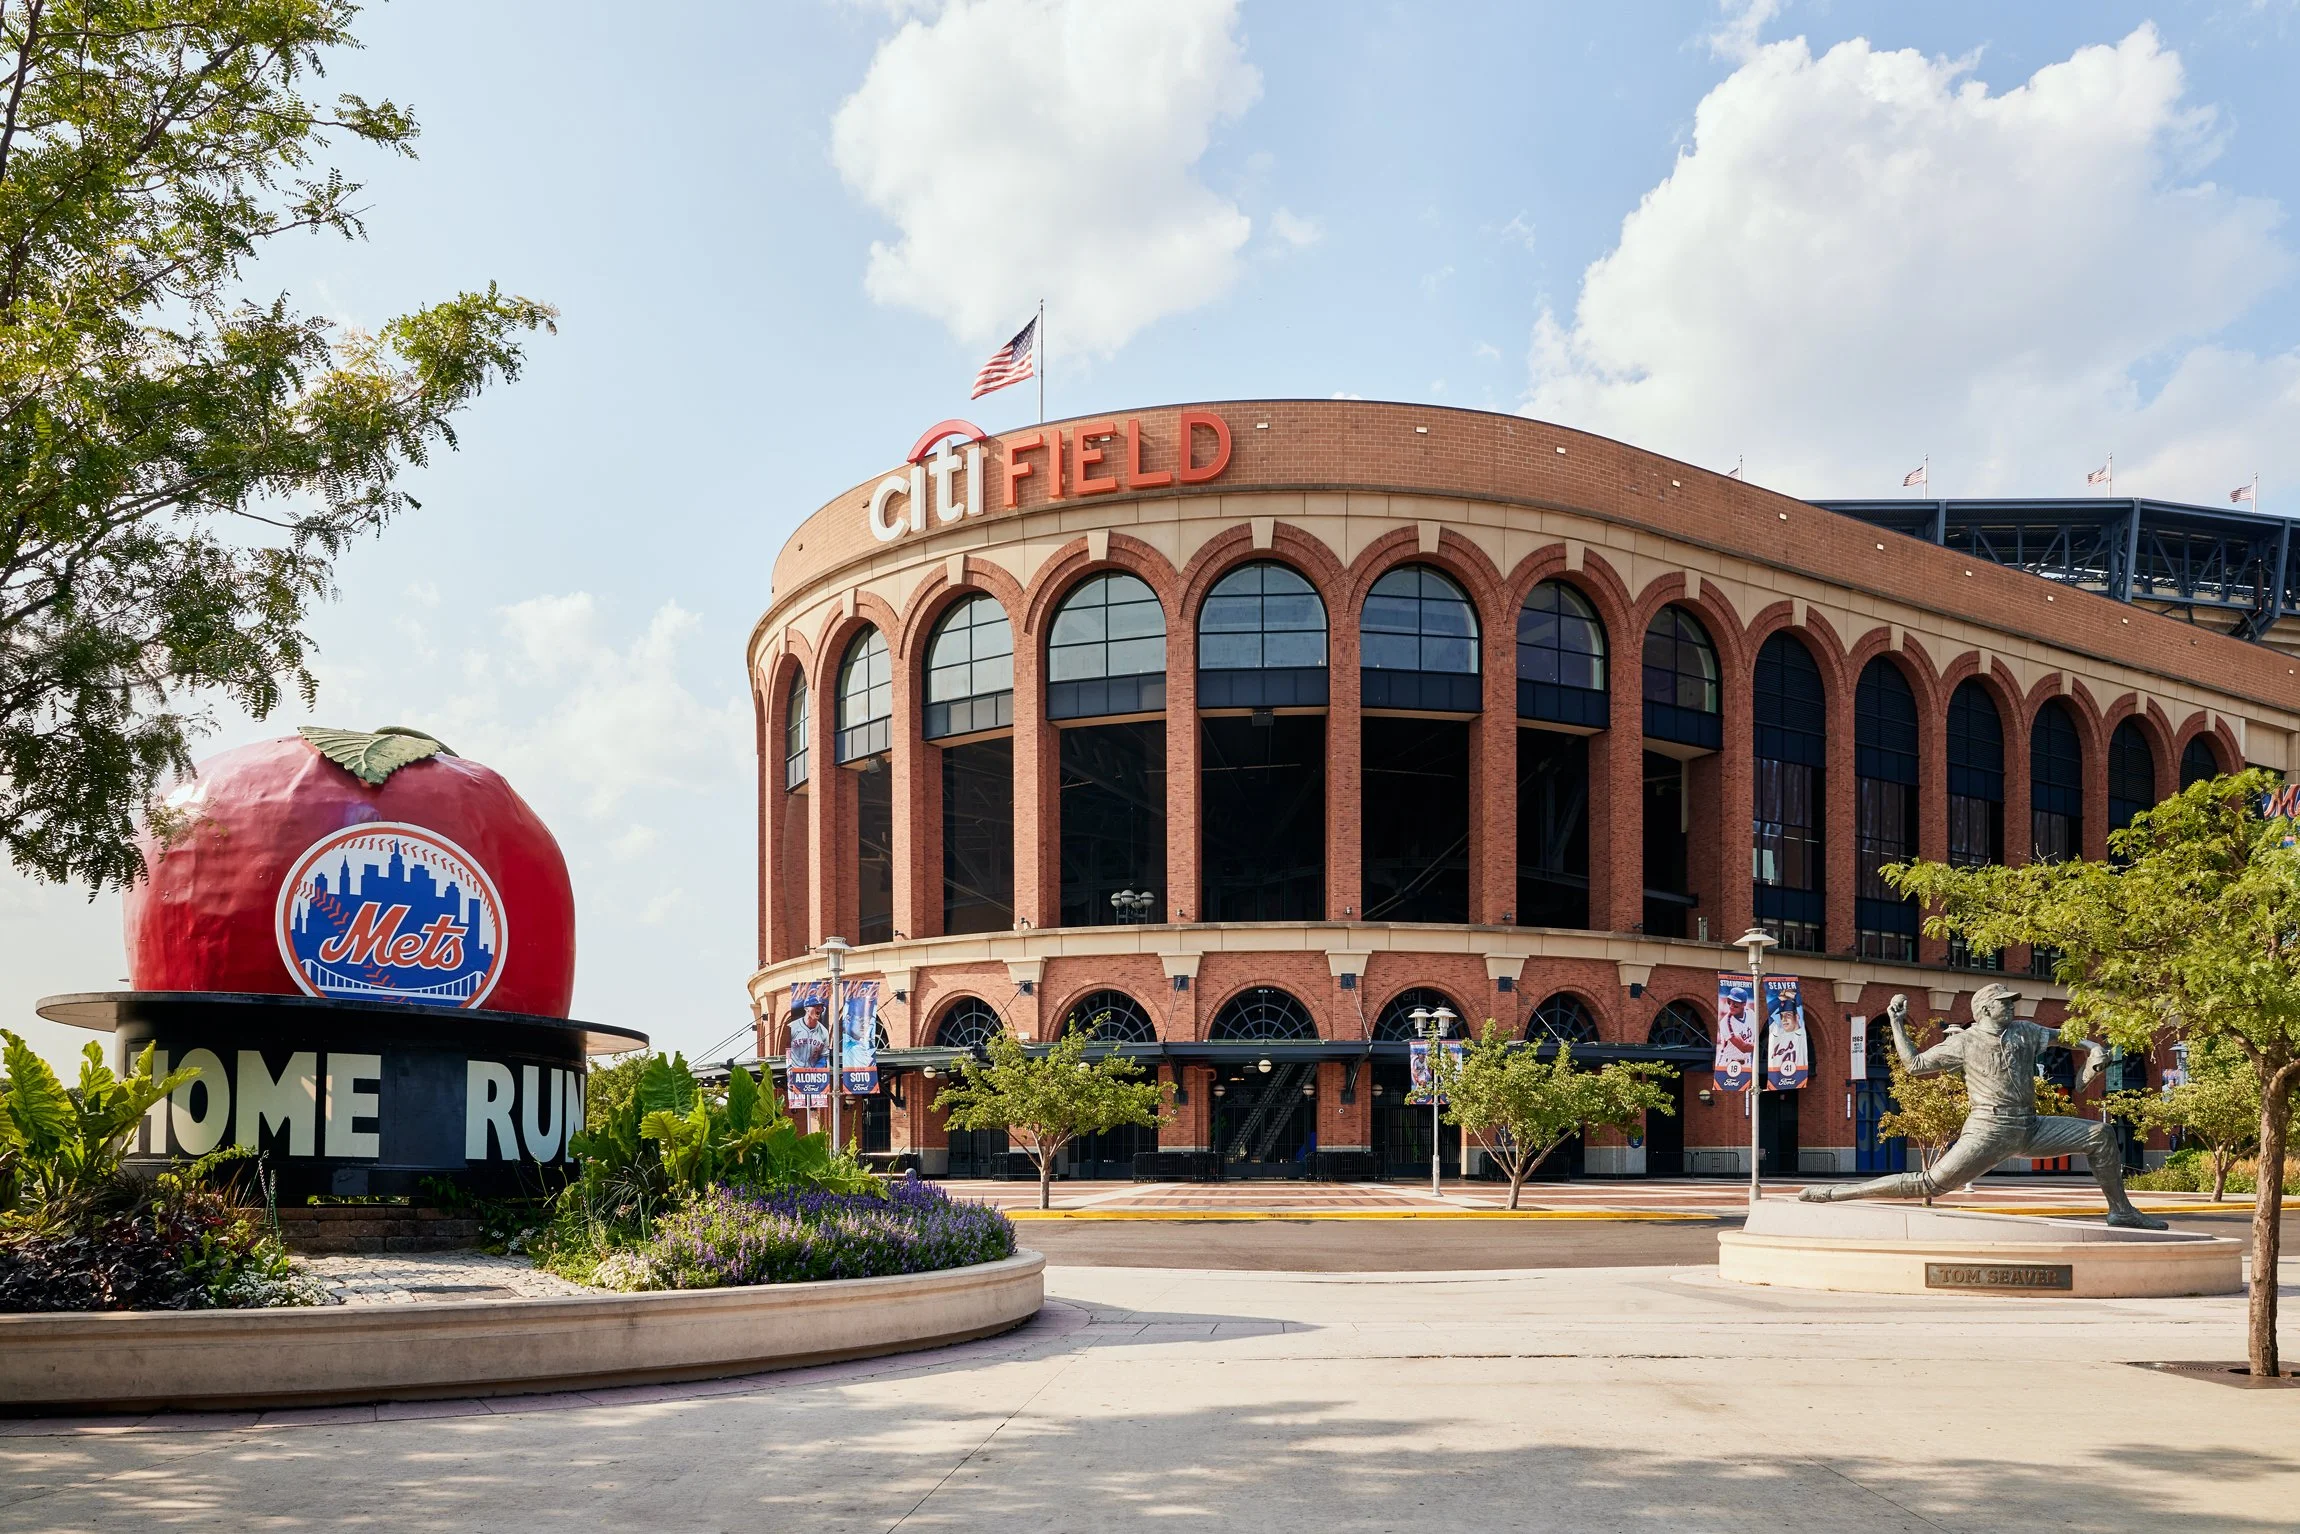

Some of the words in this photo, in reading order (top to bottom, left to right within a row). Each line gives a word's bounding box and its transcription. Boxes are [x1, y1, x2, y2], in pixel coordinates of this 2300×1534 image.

[869, 438, 985, 541] citi
[1004, 412, 1231, 508] FIELD
[319, 901, 469, 971] Mets
[1720, 980, 1753, 988] STRAWBERRY
[1768, 981, 1797, 990] SEAVER
[1730, 1065, 1738, 1073] 18
[1784, 1064, 1792, 1072] 41
[795, 1072, 828, 1083] ALONSO
[850, 1072, 870, 1083] SOTO
[1778, 1077, 1796, 1086] Ford
[853, 1083, 869, 1091] Ford
[1724, 1078, 1740, 1087] Ford
[802, 1084, 820, 1092] Ford
[127, 1048, 382, 1158] HOME
[465, 1060, 585, 1163] RUN
[1940, 1269, 1981, 1284] TOM
[1987, 1270, 2057, 1285] SEAVER
